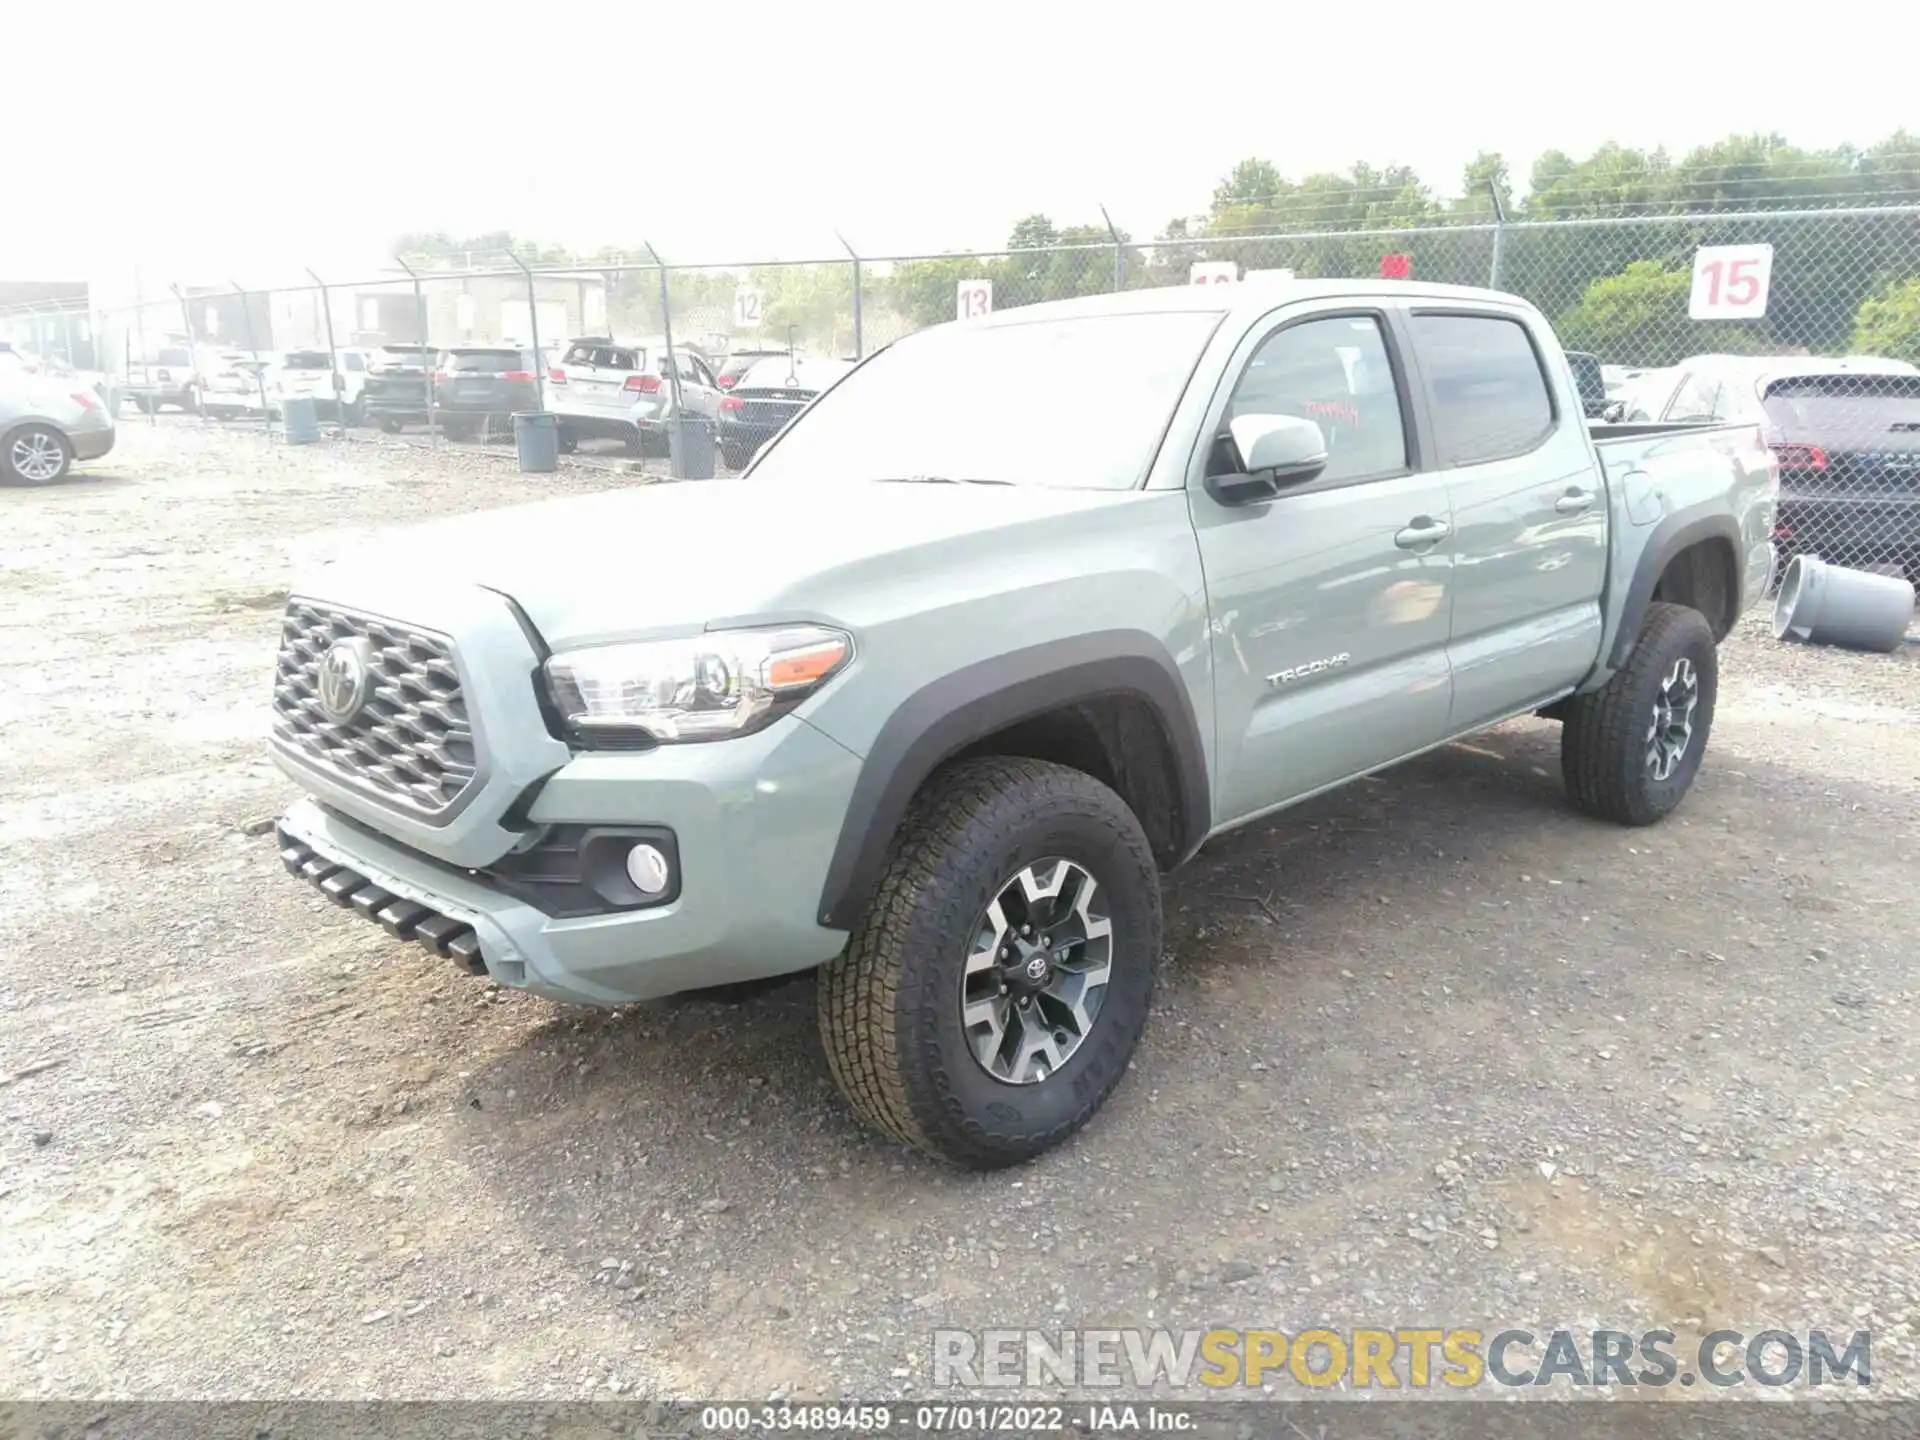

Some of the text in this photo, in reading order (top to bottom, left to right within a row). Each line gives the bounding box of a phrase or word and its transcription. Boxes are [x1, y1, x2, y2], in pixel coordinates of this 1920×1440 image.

[1700, 258, 1761, 306] 15
[737, 293, 760, 320] 12
[960, 288, 988, 319] 13
[1265, 651, 1351, 687] TACOMA
